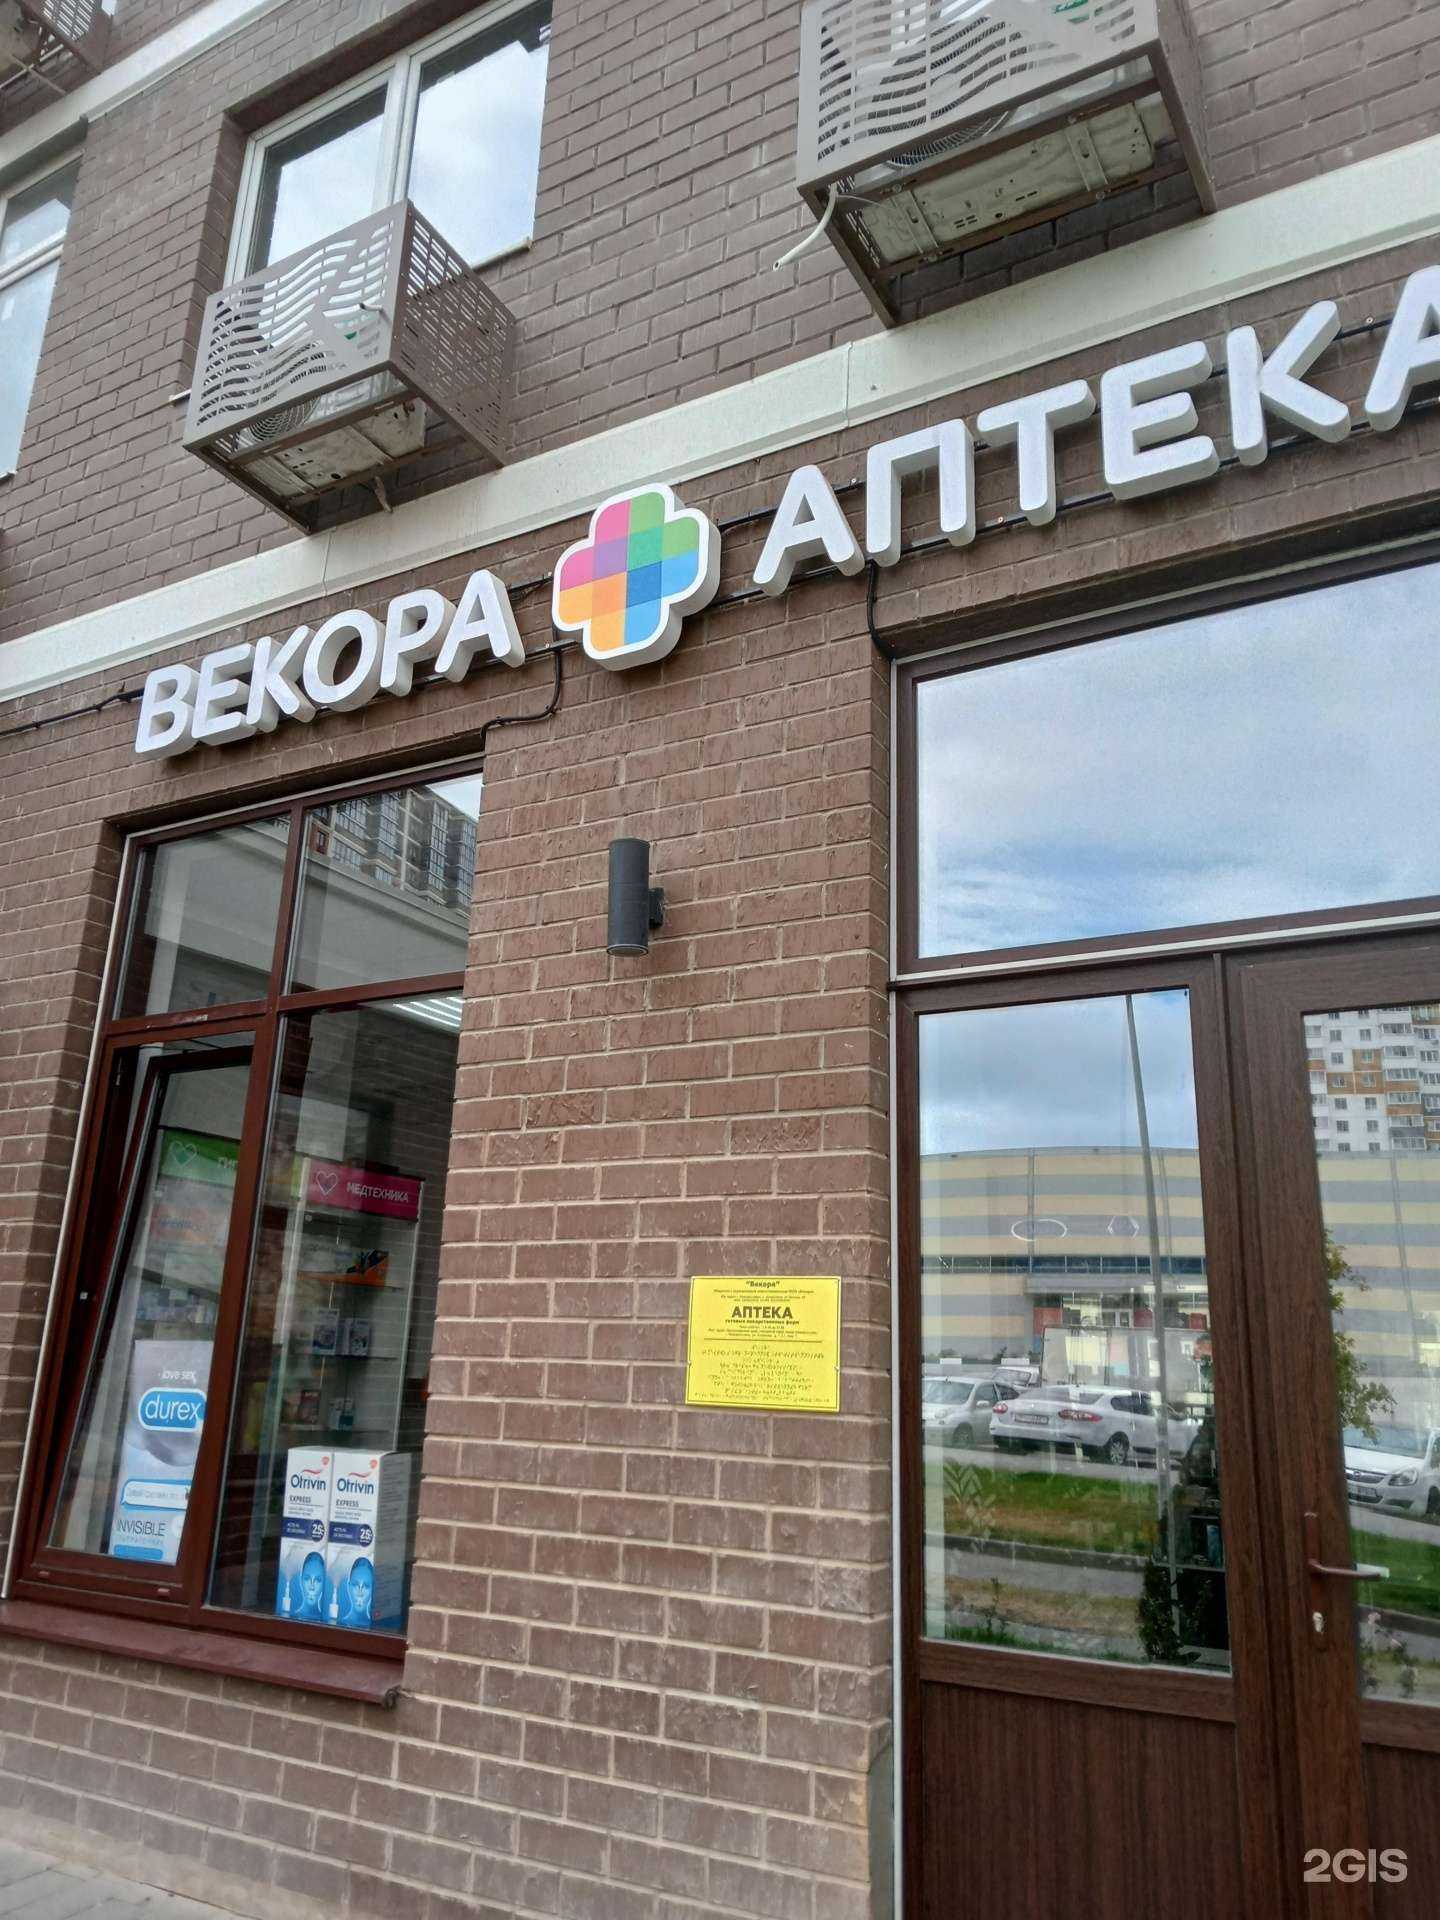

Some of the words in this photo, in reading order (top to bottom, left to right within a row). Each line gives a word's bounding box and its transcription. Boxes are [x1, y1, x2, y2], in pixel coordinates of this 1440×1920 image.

[135, 569, 526, 758] ВЕКОРА
[753, 265, 1440, 597] АПТЕКА
[346, 1182, 409, 1203] МЕДТЕХНИКА
[731, 1305, 793, 1319] АПТЕКА
[145, 1393, 202, 1422] durex
[290, 1474, 327, 1491] Otrivin
[336, 1478, 374, 1495] Otrivin
[335, 1499, 359, 1508] EXPRESS
[117, 1519, 166, 1537] INVISIBLE
